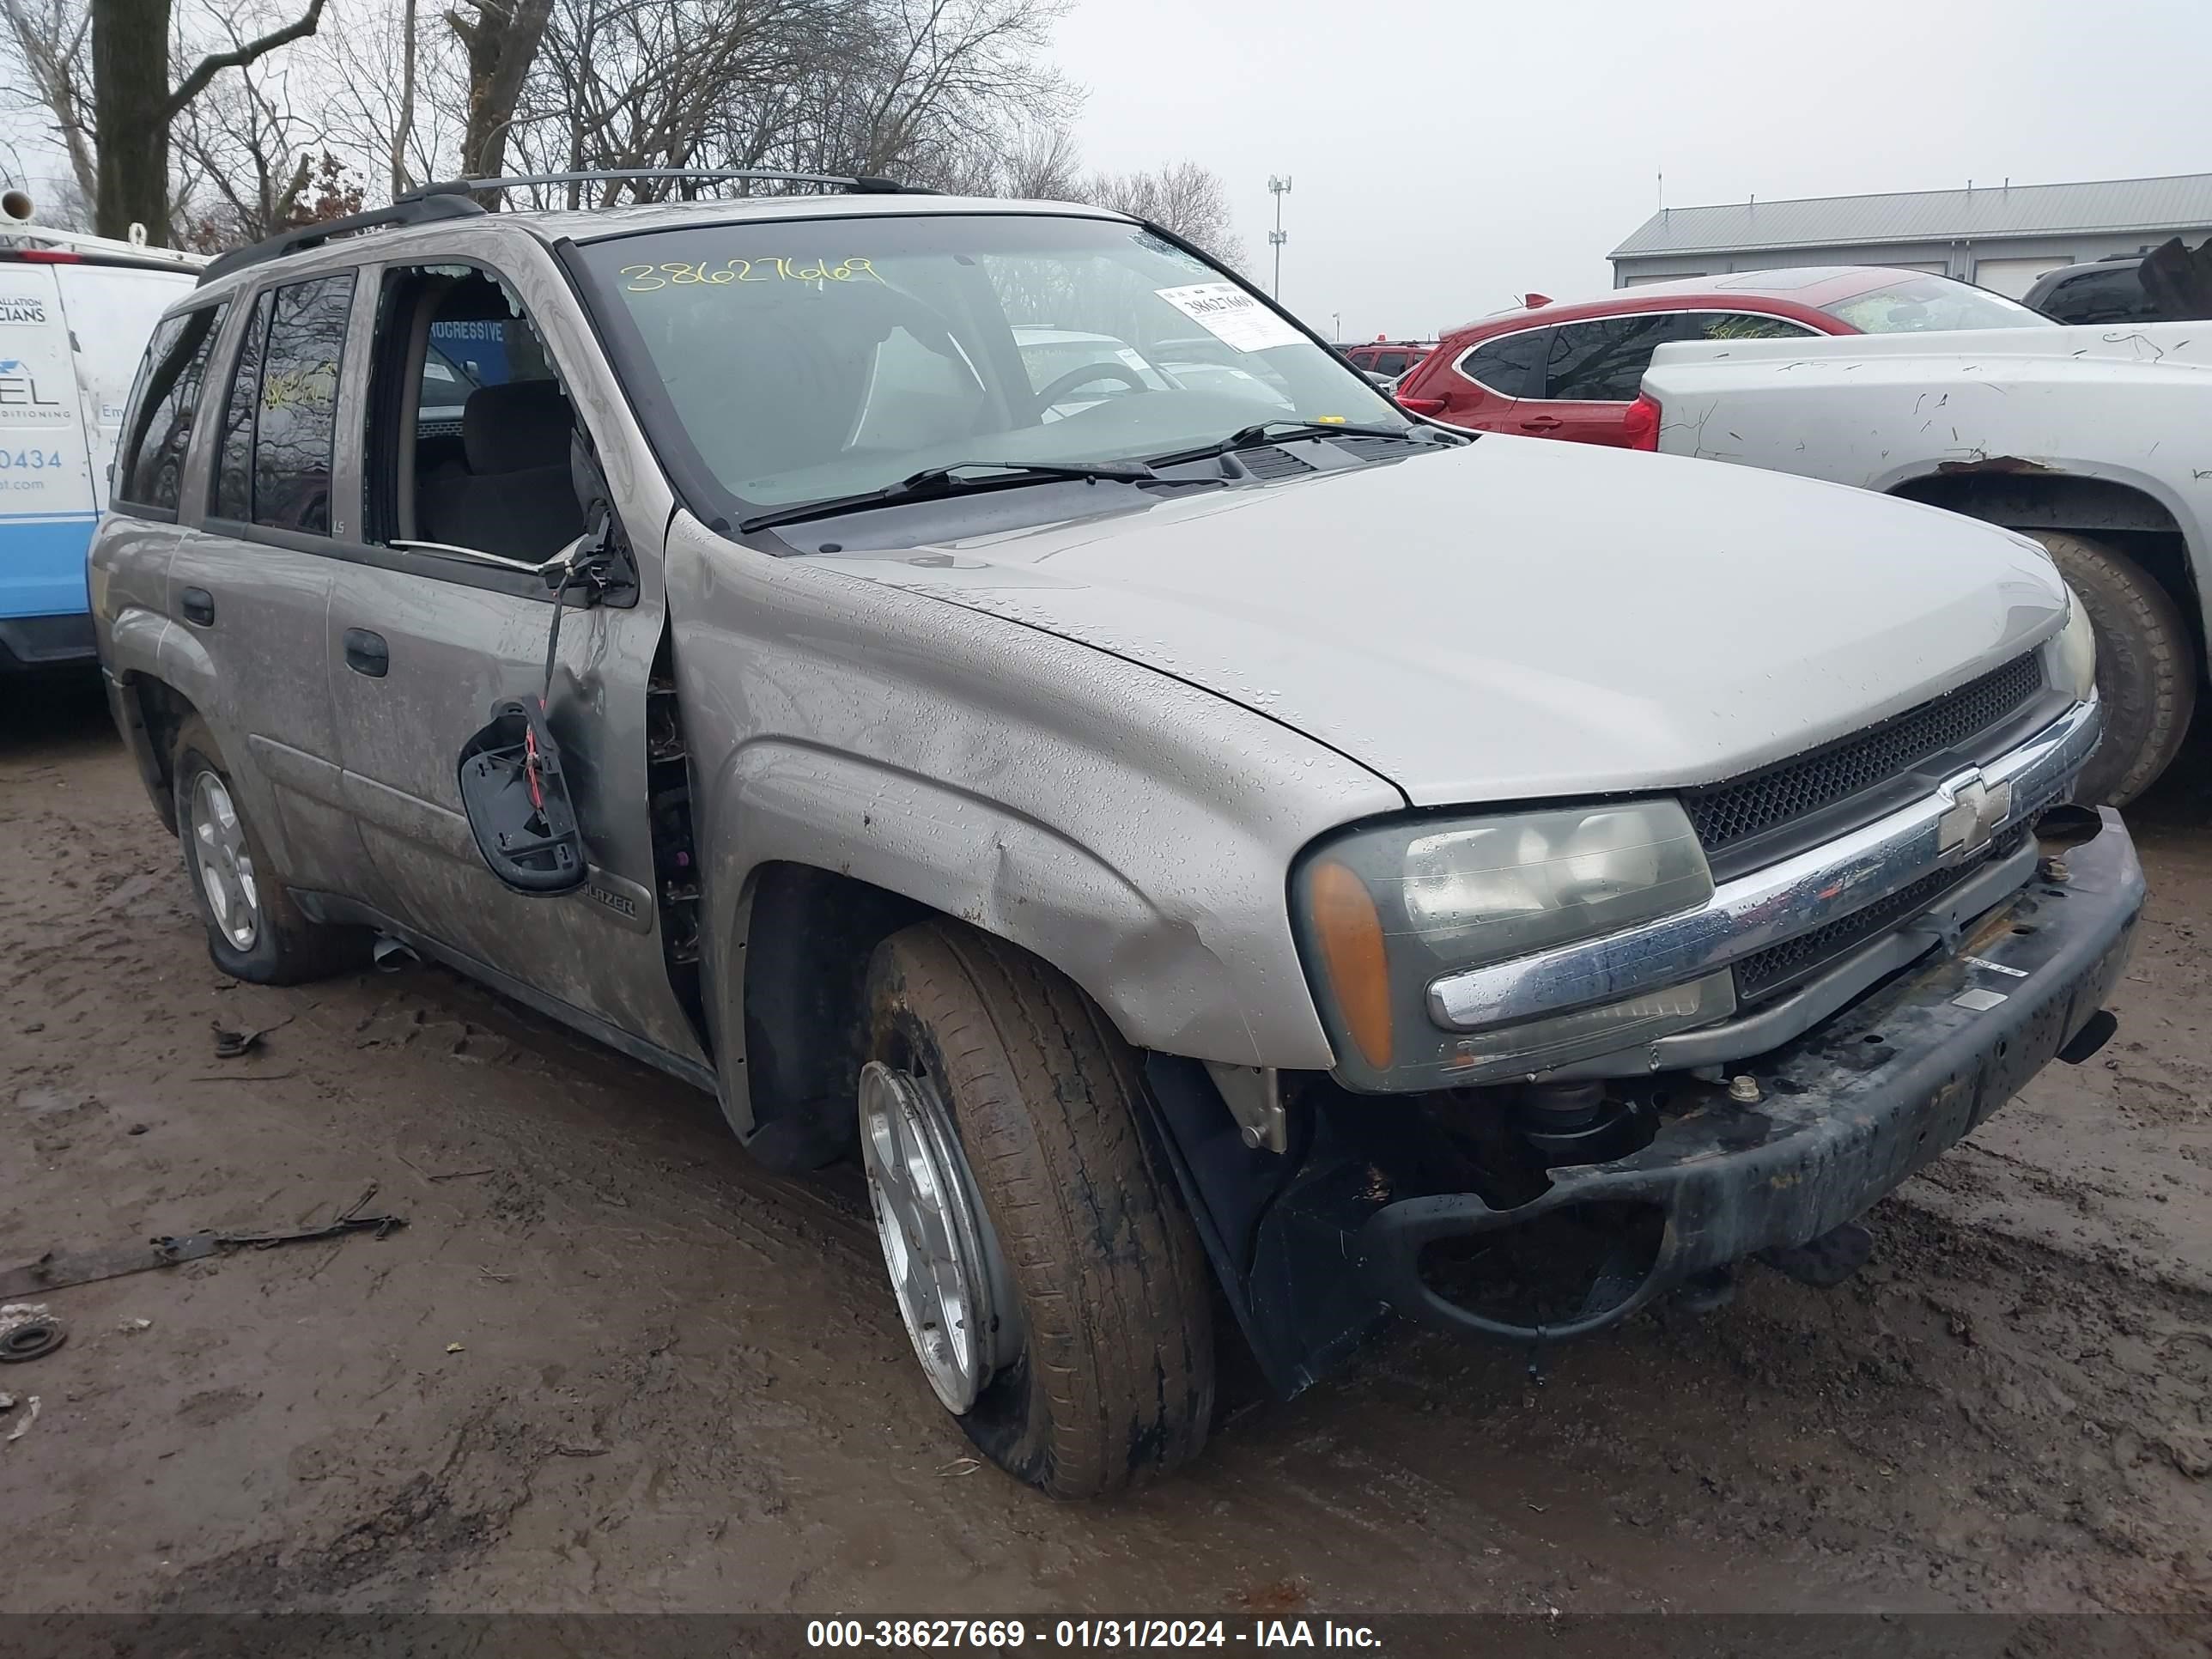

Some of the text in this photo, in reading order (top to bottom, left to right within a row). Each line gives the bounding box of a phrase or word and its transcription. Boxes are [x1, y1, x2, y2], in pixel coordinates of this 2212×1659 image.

[620, 257, 886, 291] 38627669
[1184, 295, 1254, 314] 38627669
[333, 520, 344, 534] LS
